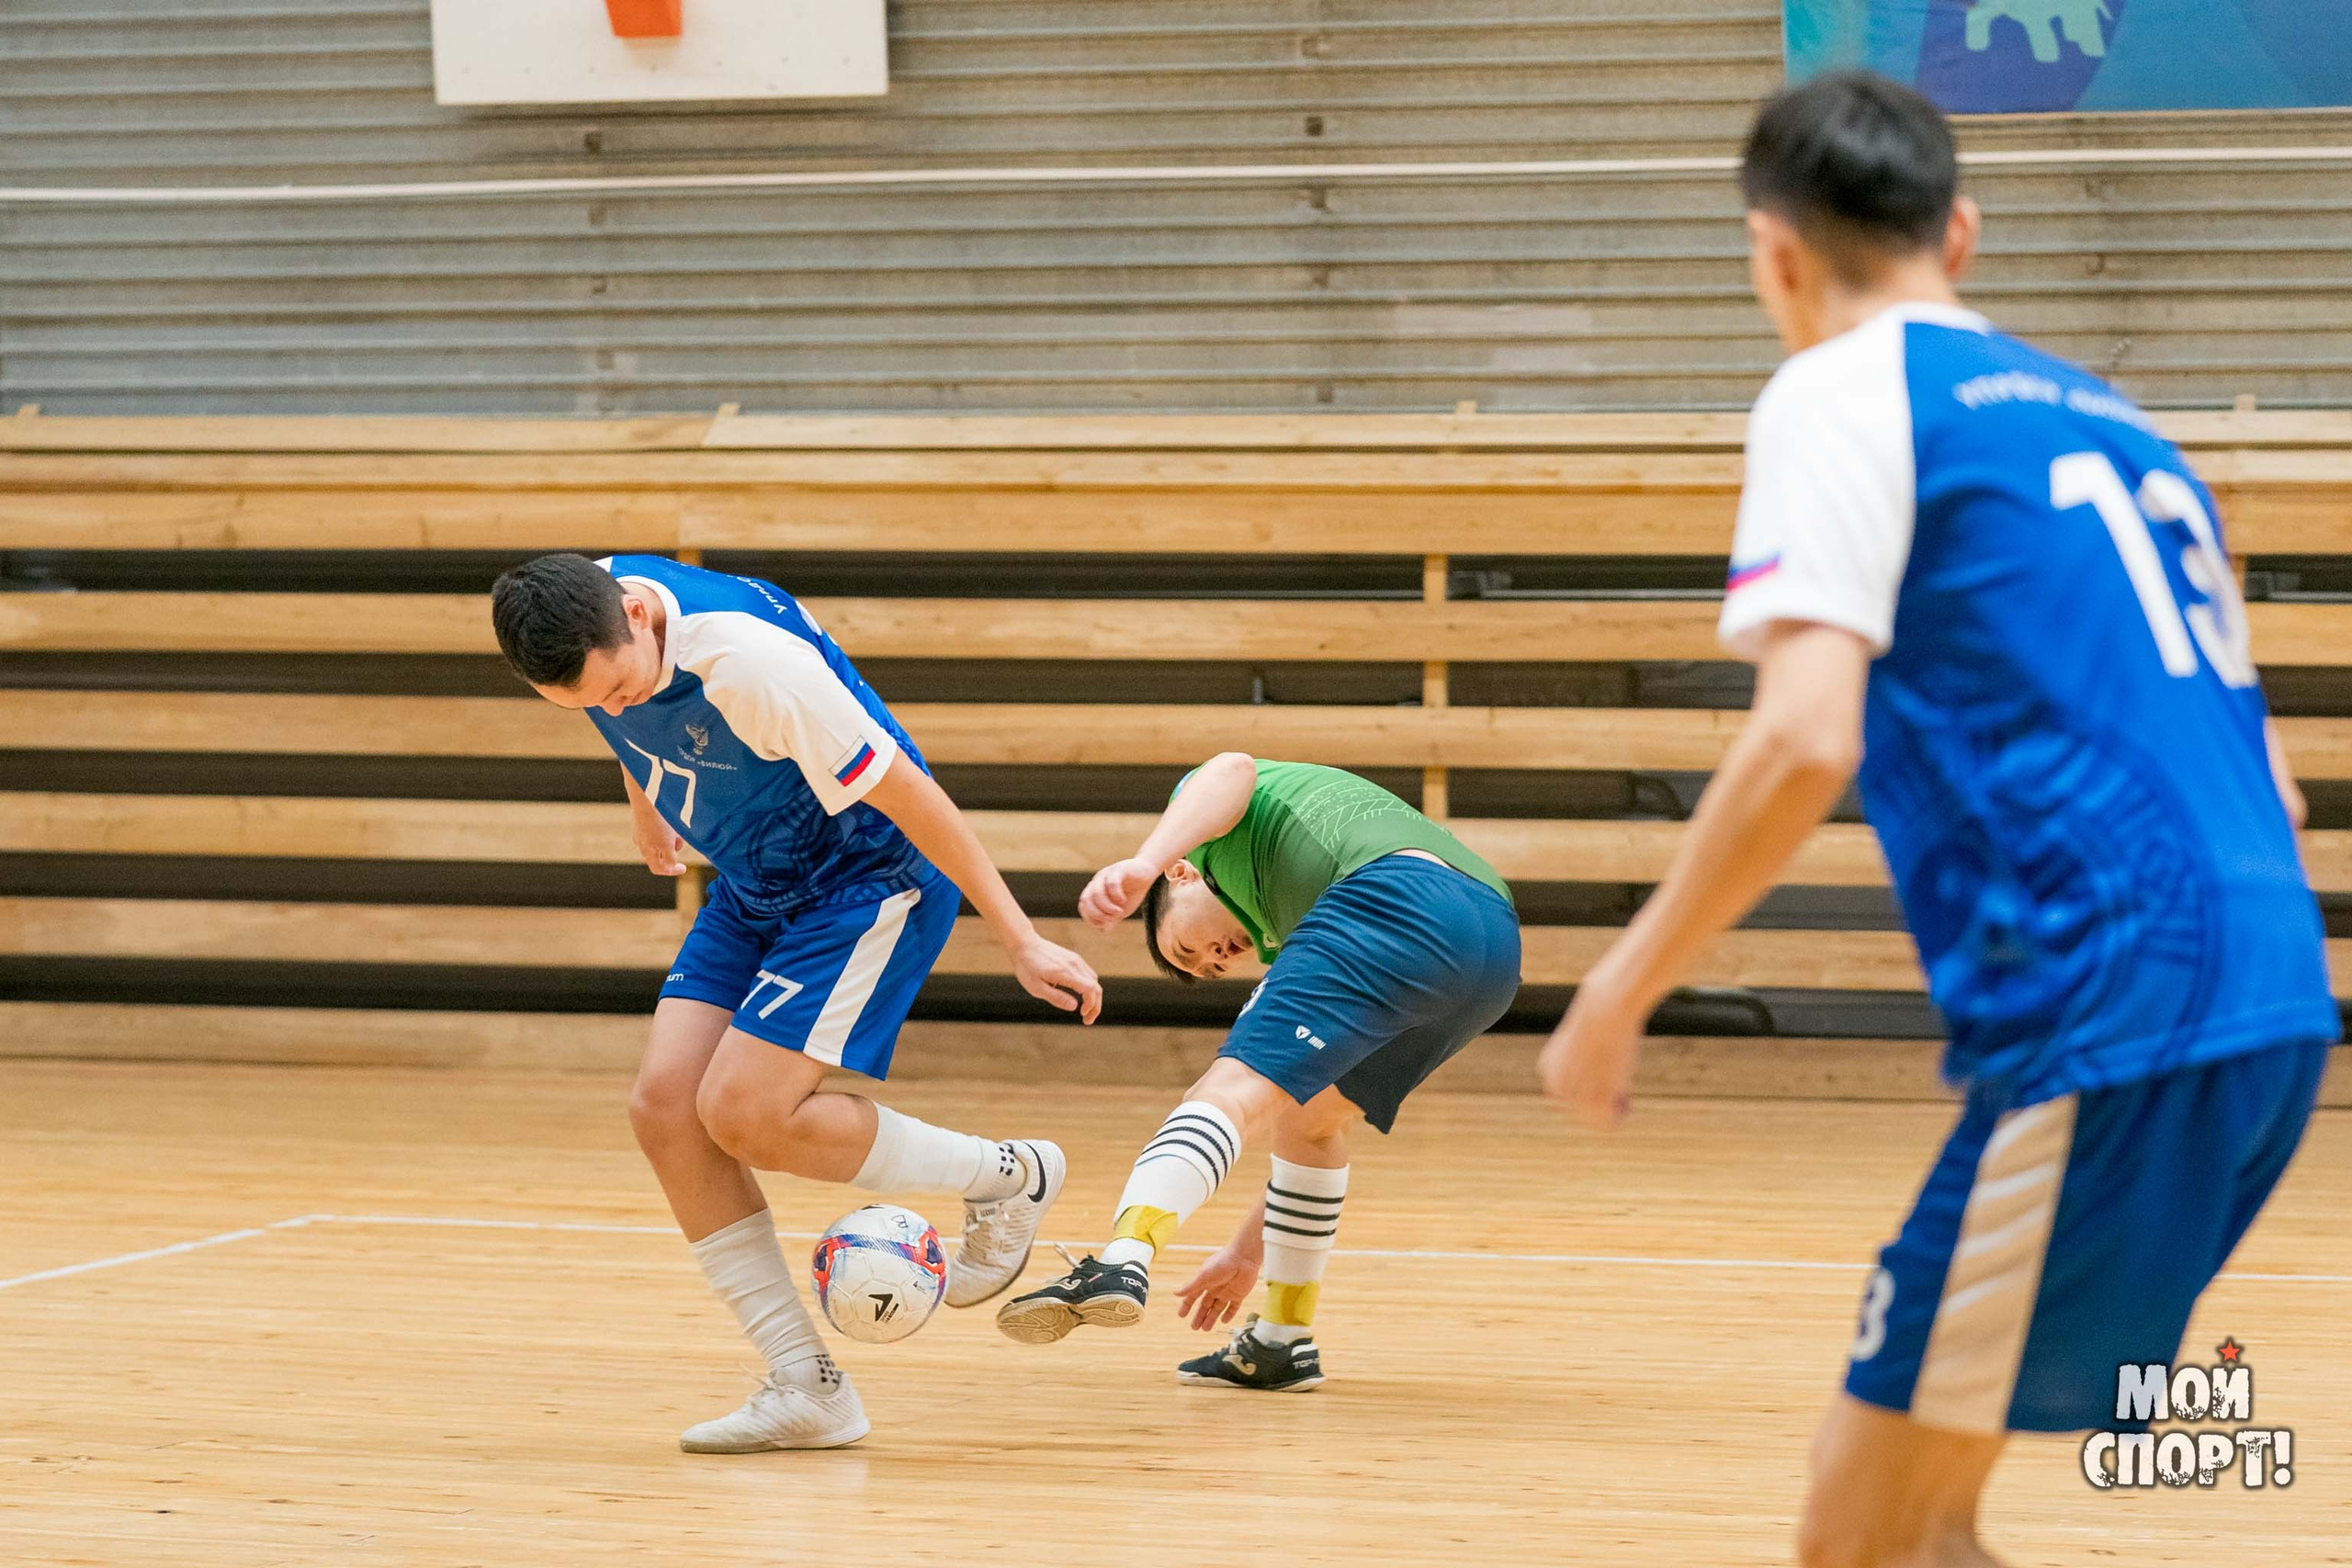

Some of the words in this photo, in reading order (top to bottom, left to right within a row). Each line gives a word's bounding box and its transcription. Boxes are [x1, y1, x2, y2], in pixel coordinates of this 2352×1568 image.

[2050, 451, 2259, 691] 13
[624, 737, 696, 829] 77
[741, 969, 804, 1020] 77
